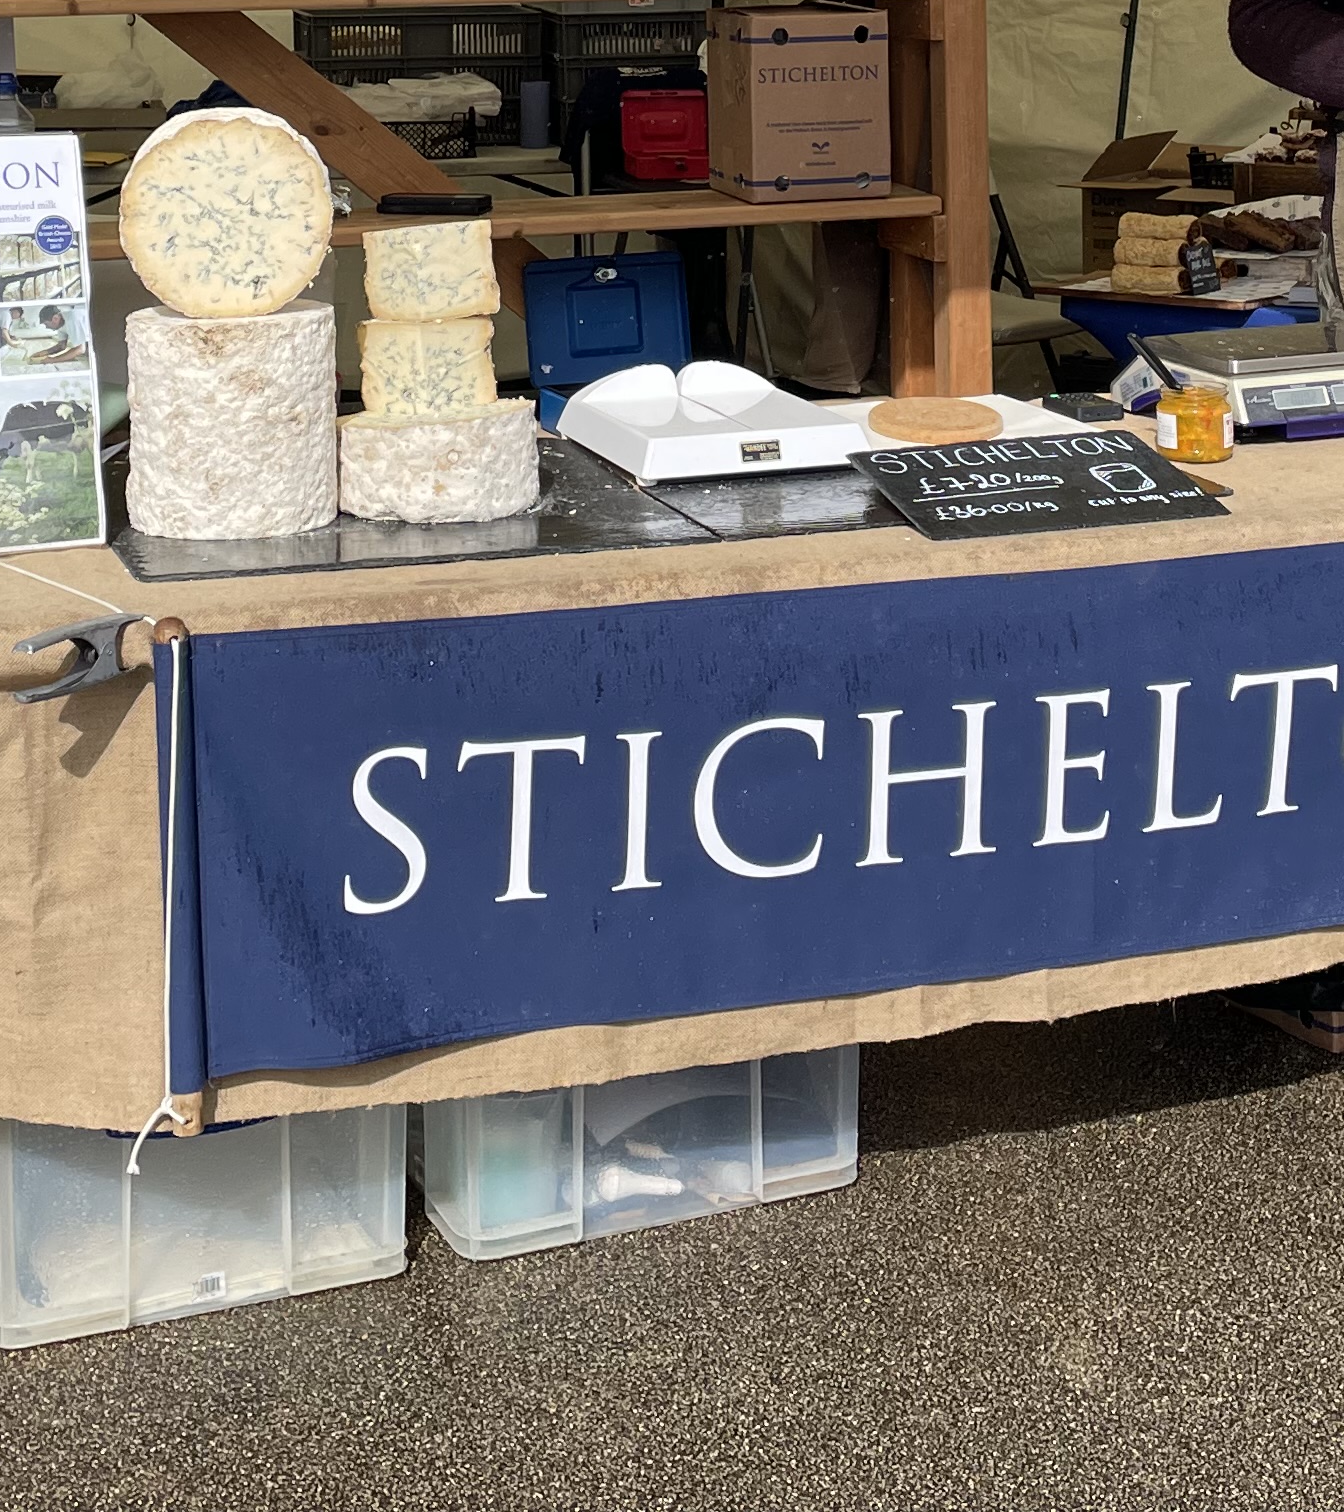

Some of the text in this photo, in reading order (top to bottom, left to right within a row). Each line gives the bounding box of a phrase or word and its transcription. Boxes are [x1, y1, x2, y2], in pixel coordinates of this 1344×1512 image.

[757, 64, 880, 85] STICHELTON
[37, 199, 56, 210] milk
[869, 434, 1135, 475] STICHELTON
[1088, 495, 1118, 507] cut
[1120, 495, 1138, 506] to
